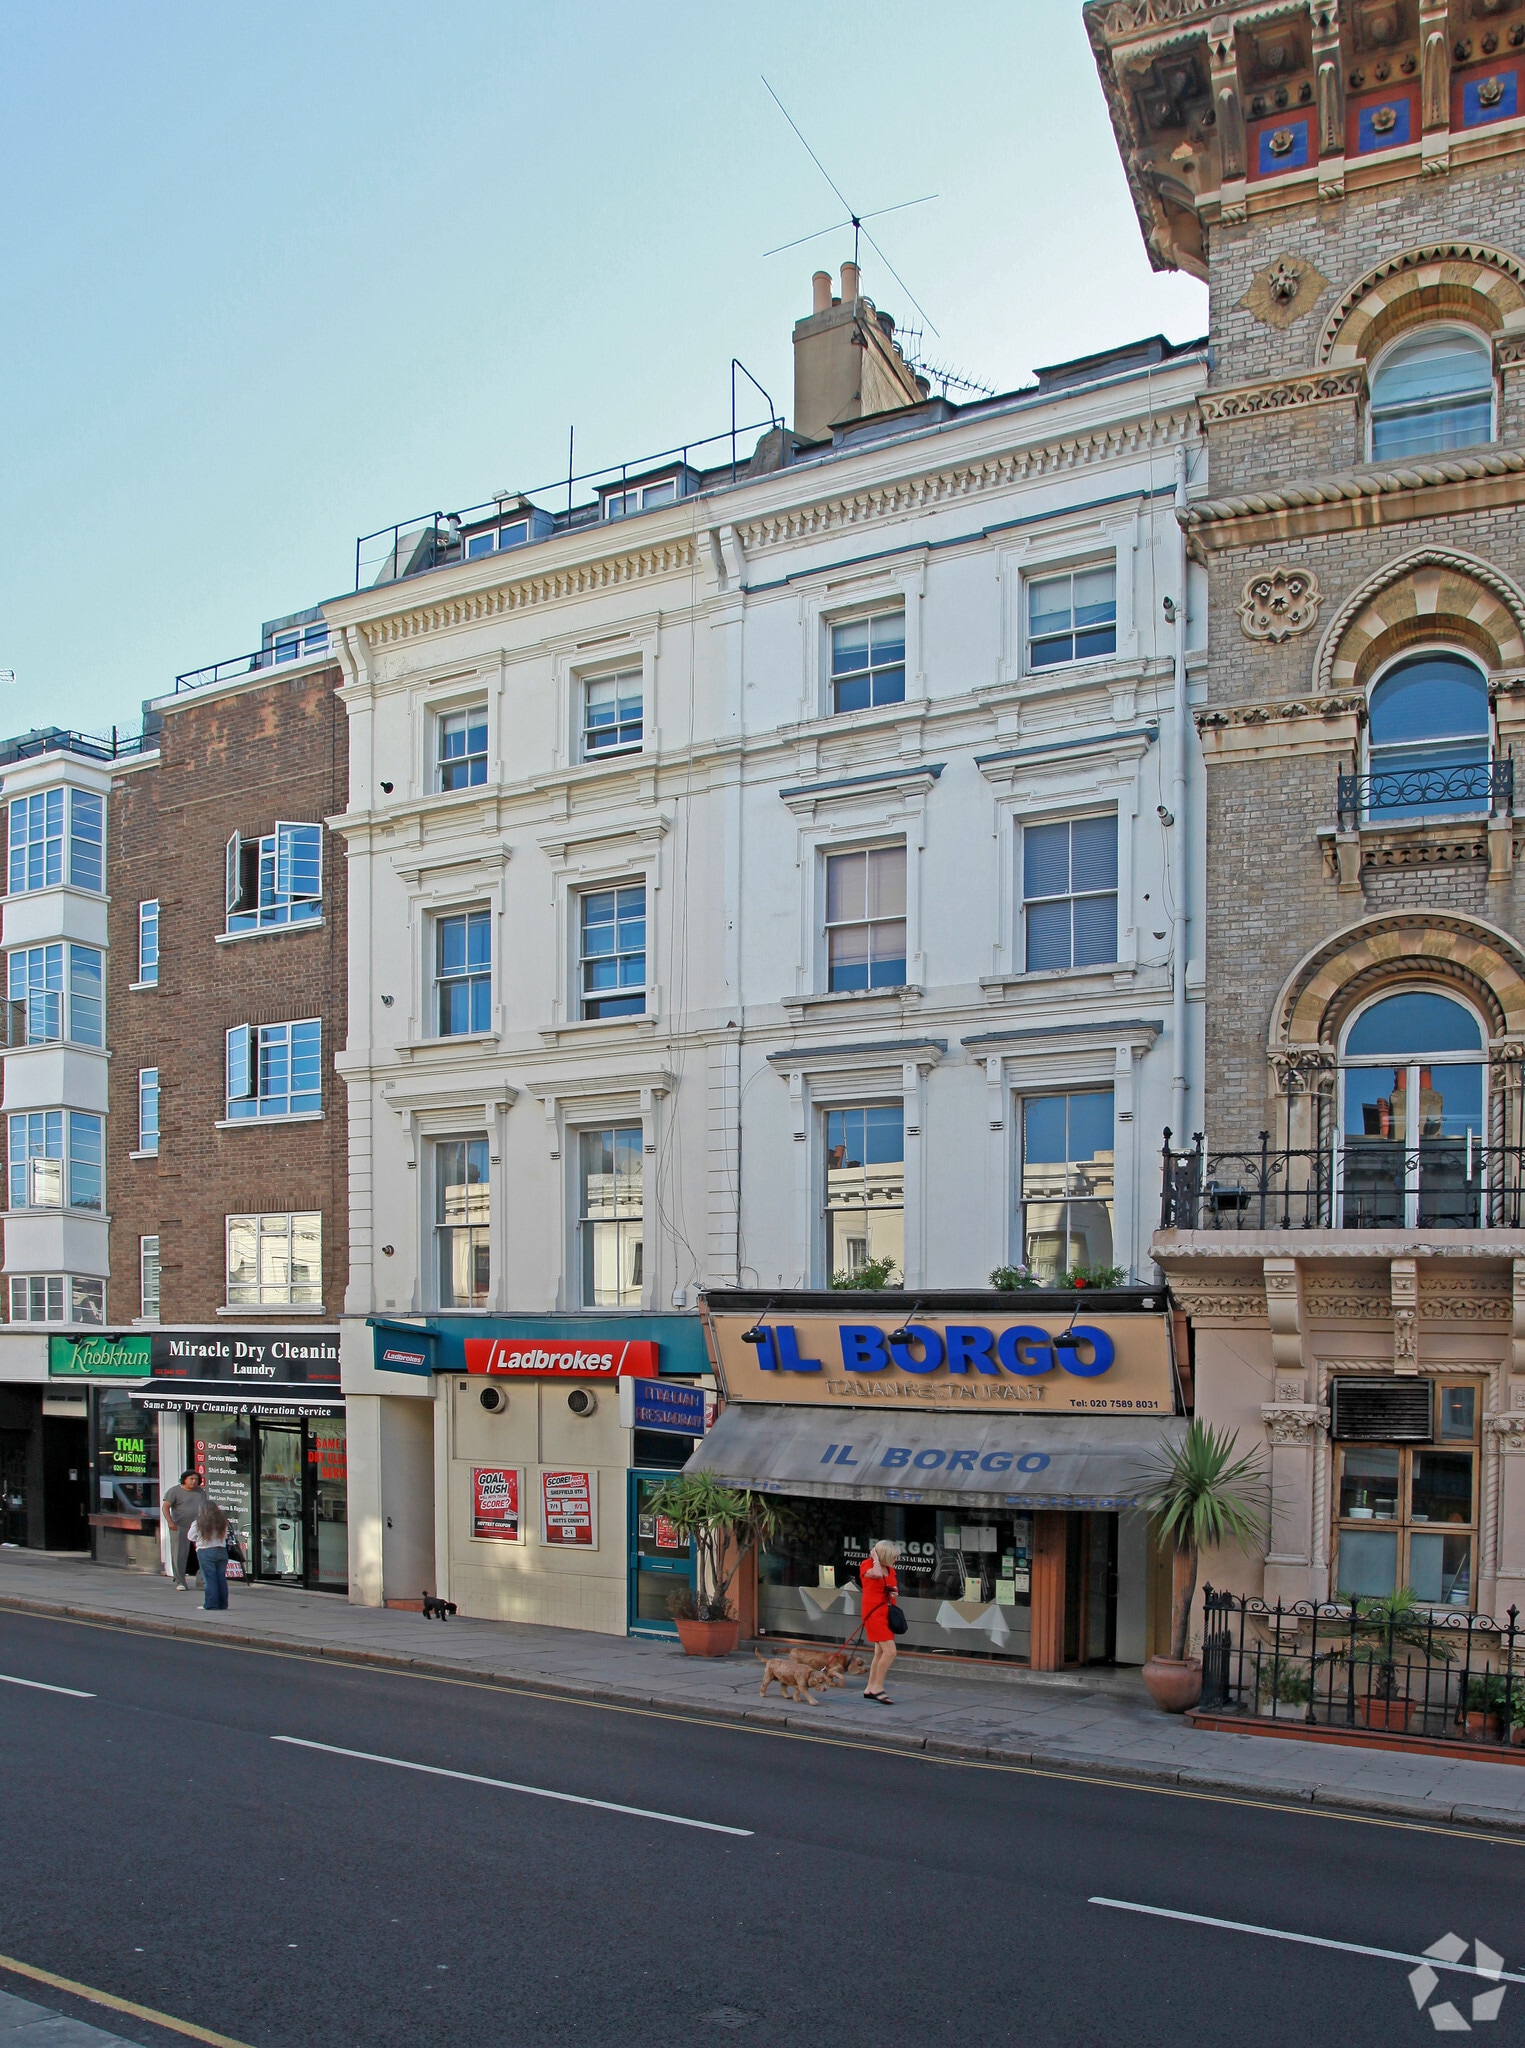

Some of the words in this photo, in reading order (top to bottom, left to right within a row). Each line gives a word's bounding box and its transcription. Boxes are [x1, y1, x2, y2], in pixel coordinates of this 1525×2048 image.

[70, 1338, 150, 1373] Khobkhun
[169, 1341, 230, 1358] Miracle
[235, 1341, 265, 1361] Dry
[387, 1352, 422, 1363] Ladbrokes
[754, 1325, 822, 1373] IL
[839, 1324, 1115, 1378] BORGO
[497, 1350, 613, 1370] Ladbrokes
[233, 1363, 276, 1377] Laundry
[825, 1379, 899, 1397] ITALIAN
[903, 1381, 1045, 1400] RESTAURANT
[143, 1400, 165, 1409] Same
[167, 1401, 182, 1411] Day
[185, 1402, 200, 1412] Dry
[202, 1403, 238, 1414] Cleaning
[240, 1404, 248, 1413] &
[250, 1405, 295, 1415] Alteration
[297, 1406, 331, 1416] Service
[1070, 1399, 1088, 1407] Tel:
[1090, 1399, 1107, 1407] 020
[1110, 1400, 1133, 1408] 7589
[1136, 1400, 1159, 1408] 8031
[115, 1437, 144, 1452] THAI
[316, 1437, 341, 1449] SAME
[113, 1452, 146, 1463] CUISINE
[308, 1452, 324, 1463] DRY
[820, 1444, 859, 1465] IL
[880, 1447, 1051, 1473] BORGO
[479, 1473, 504, 1485] GOAL
[547, 1475, 571, 1485] SCORE!
[483, 1484, 508, 1494] RUSH
[886, 1488, 923, 1501] Bar
[482, 1499, 510, 1508] SCORE?
[844, 1536, 861, 1549] IL
